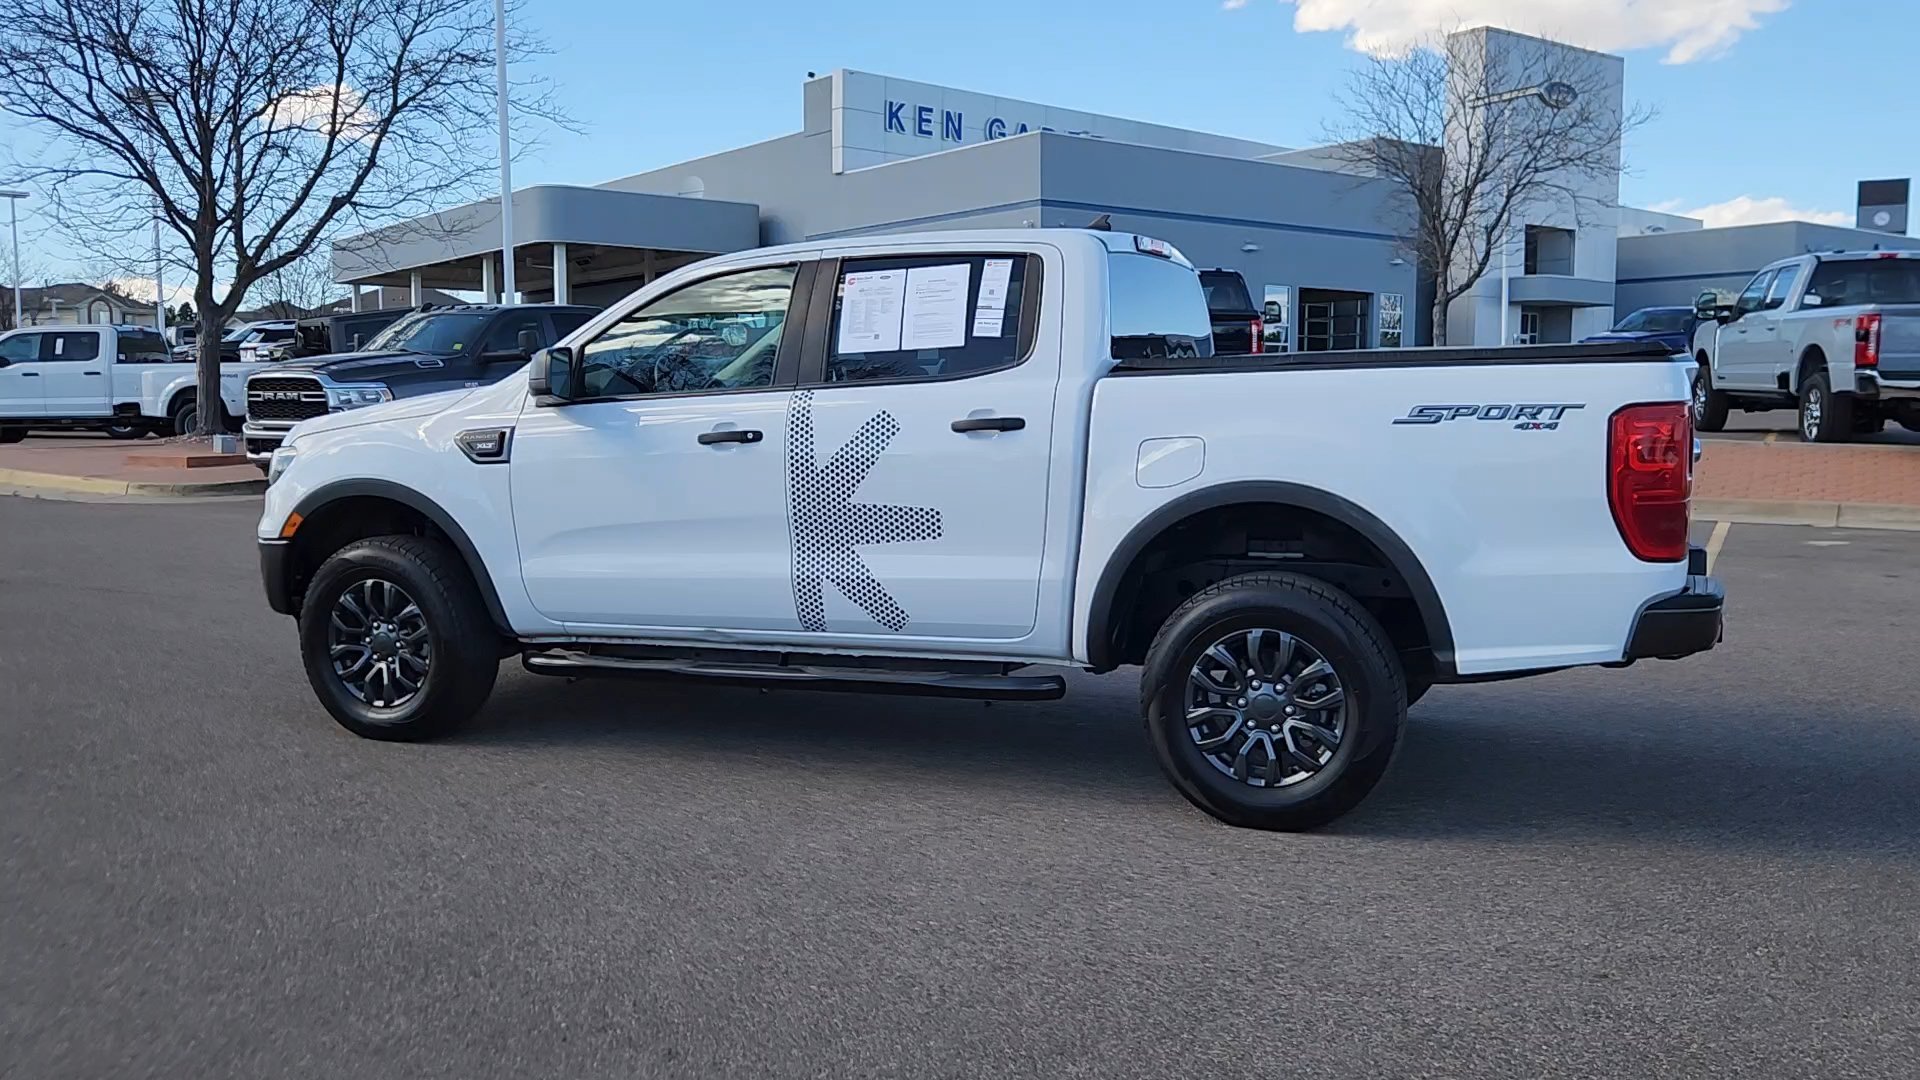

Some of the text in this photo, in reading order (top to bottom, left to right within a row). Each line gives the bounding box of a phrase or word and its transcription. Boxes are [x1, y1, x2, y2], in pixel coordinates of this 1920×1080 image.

[886, 100, 964, 142] KEN
[262, 391, 299, 400] RAM
[1392, 403, 1586, 425] SPORT
